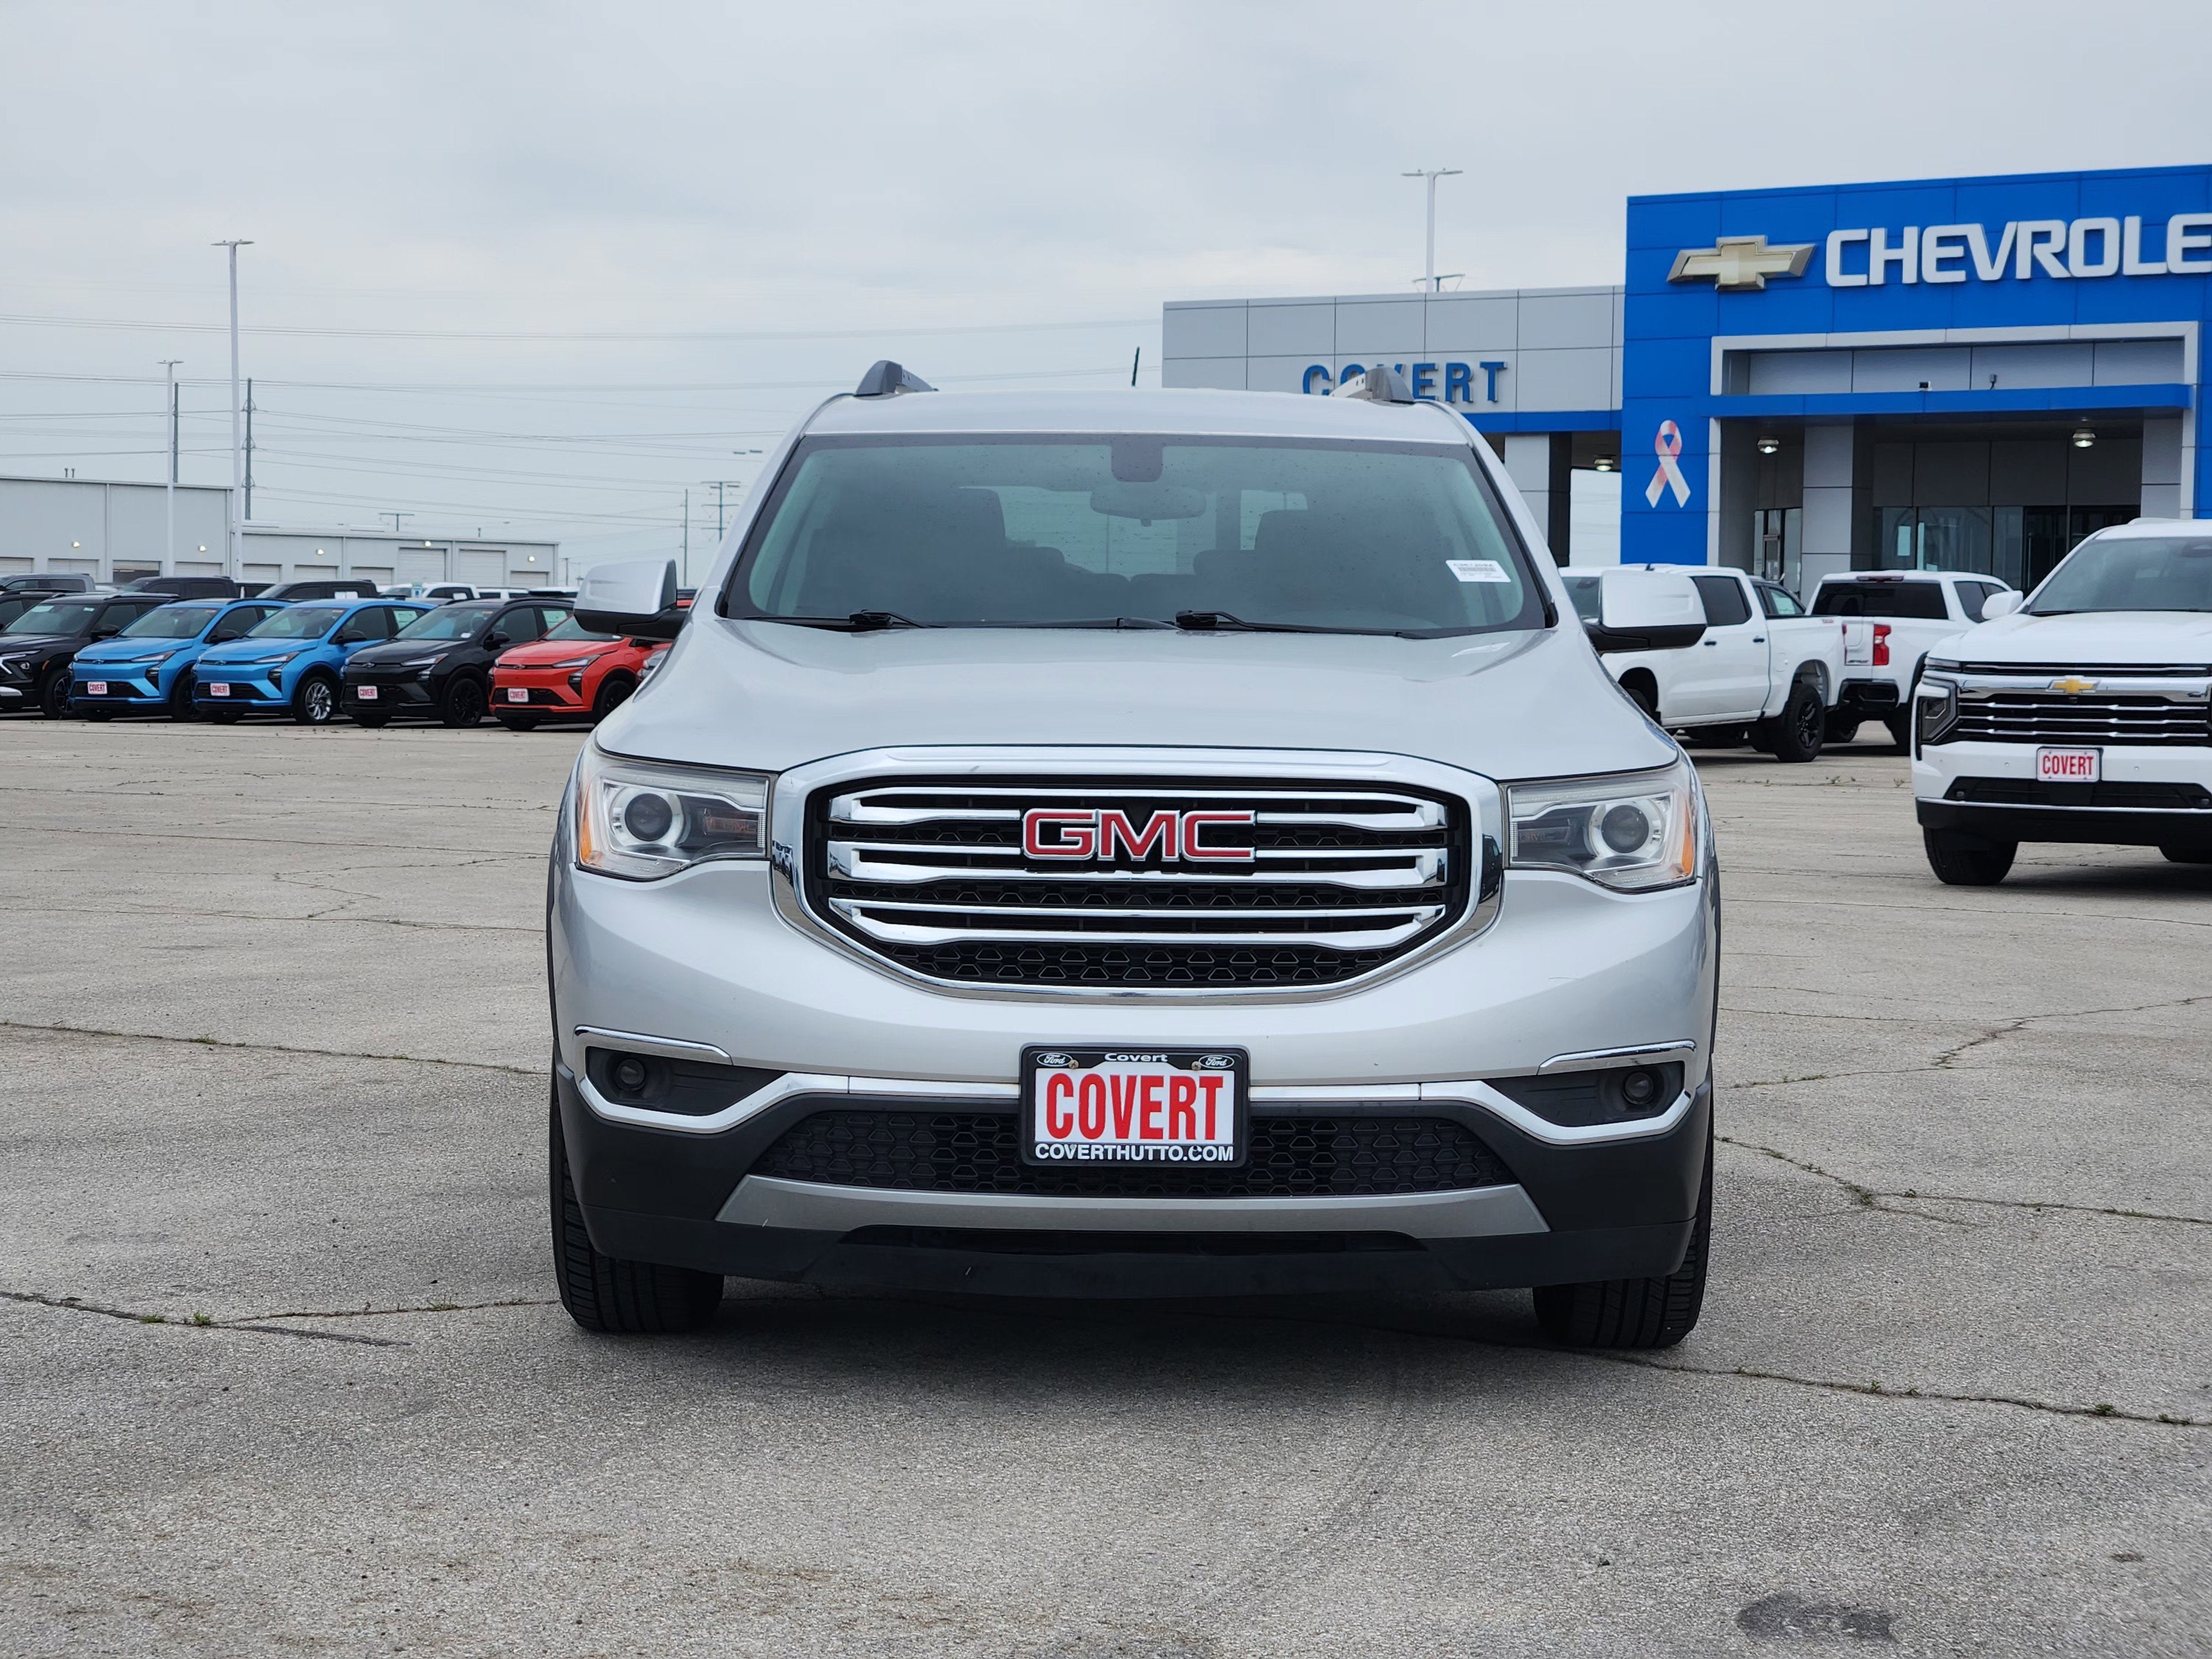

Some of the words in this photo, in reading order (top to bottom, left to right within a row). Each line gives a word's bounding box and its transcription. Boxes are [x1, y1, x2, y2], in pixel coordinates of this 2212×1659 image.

[1826, 213, 2212, 286] CHEVROLE
[1302, 361, 1508, 403] CERT
[2043, 755, 2094, 775] COVERT
[1023, 808, 1255, 862] GMC
[1105, 1053, 1168, 1062] Covert
[1046, 1073, 1224, 1140] COVERT
[1035, 1143, 1234, 1162] COVERTHUTTO.COM
